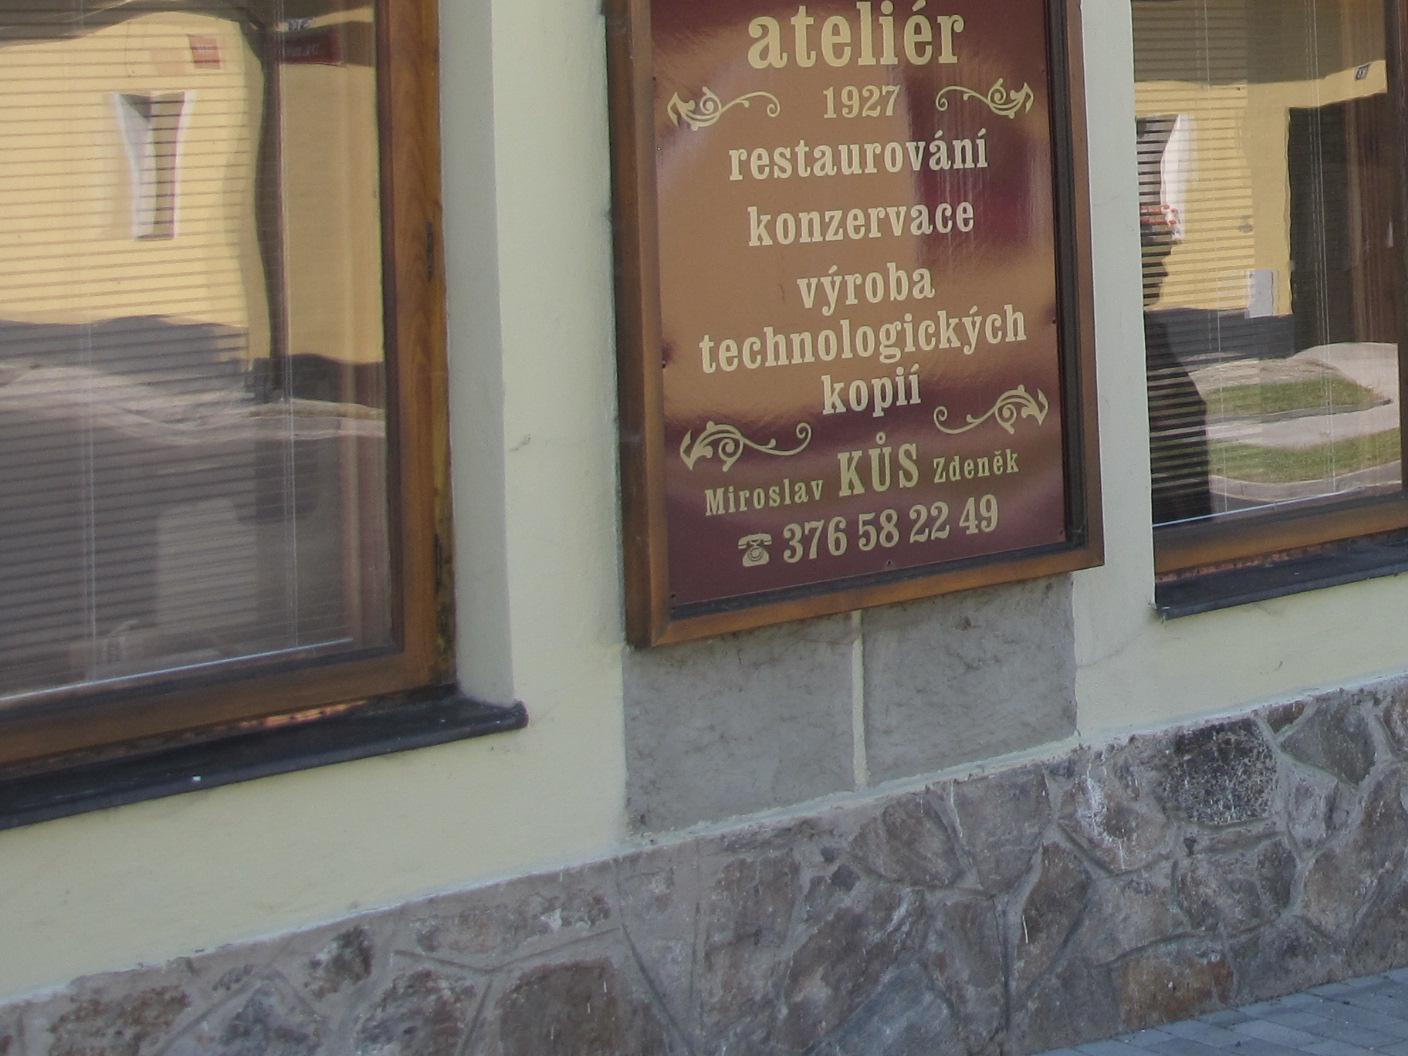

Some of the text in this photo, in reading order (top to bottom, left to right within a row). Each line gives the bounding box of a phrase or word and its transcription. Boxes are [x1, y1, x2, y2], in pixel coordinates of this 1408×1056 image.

[822, 84, 901, 119] 1927
[729, 128, 988, 181] restaurování
[747, 199, 975, 247] konzervace
[797, 262, 935, 317] výroba
[699, 304, 1028, 374] technologických
[821, 363, 922, 418] kopií
[704, 431, 1020, 517] Miroslav KŮS Zdeněk
[783, 494, 999, 564] 376 58 22 49
